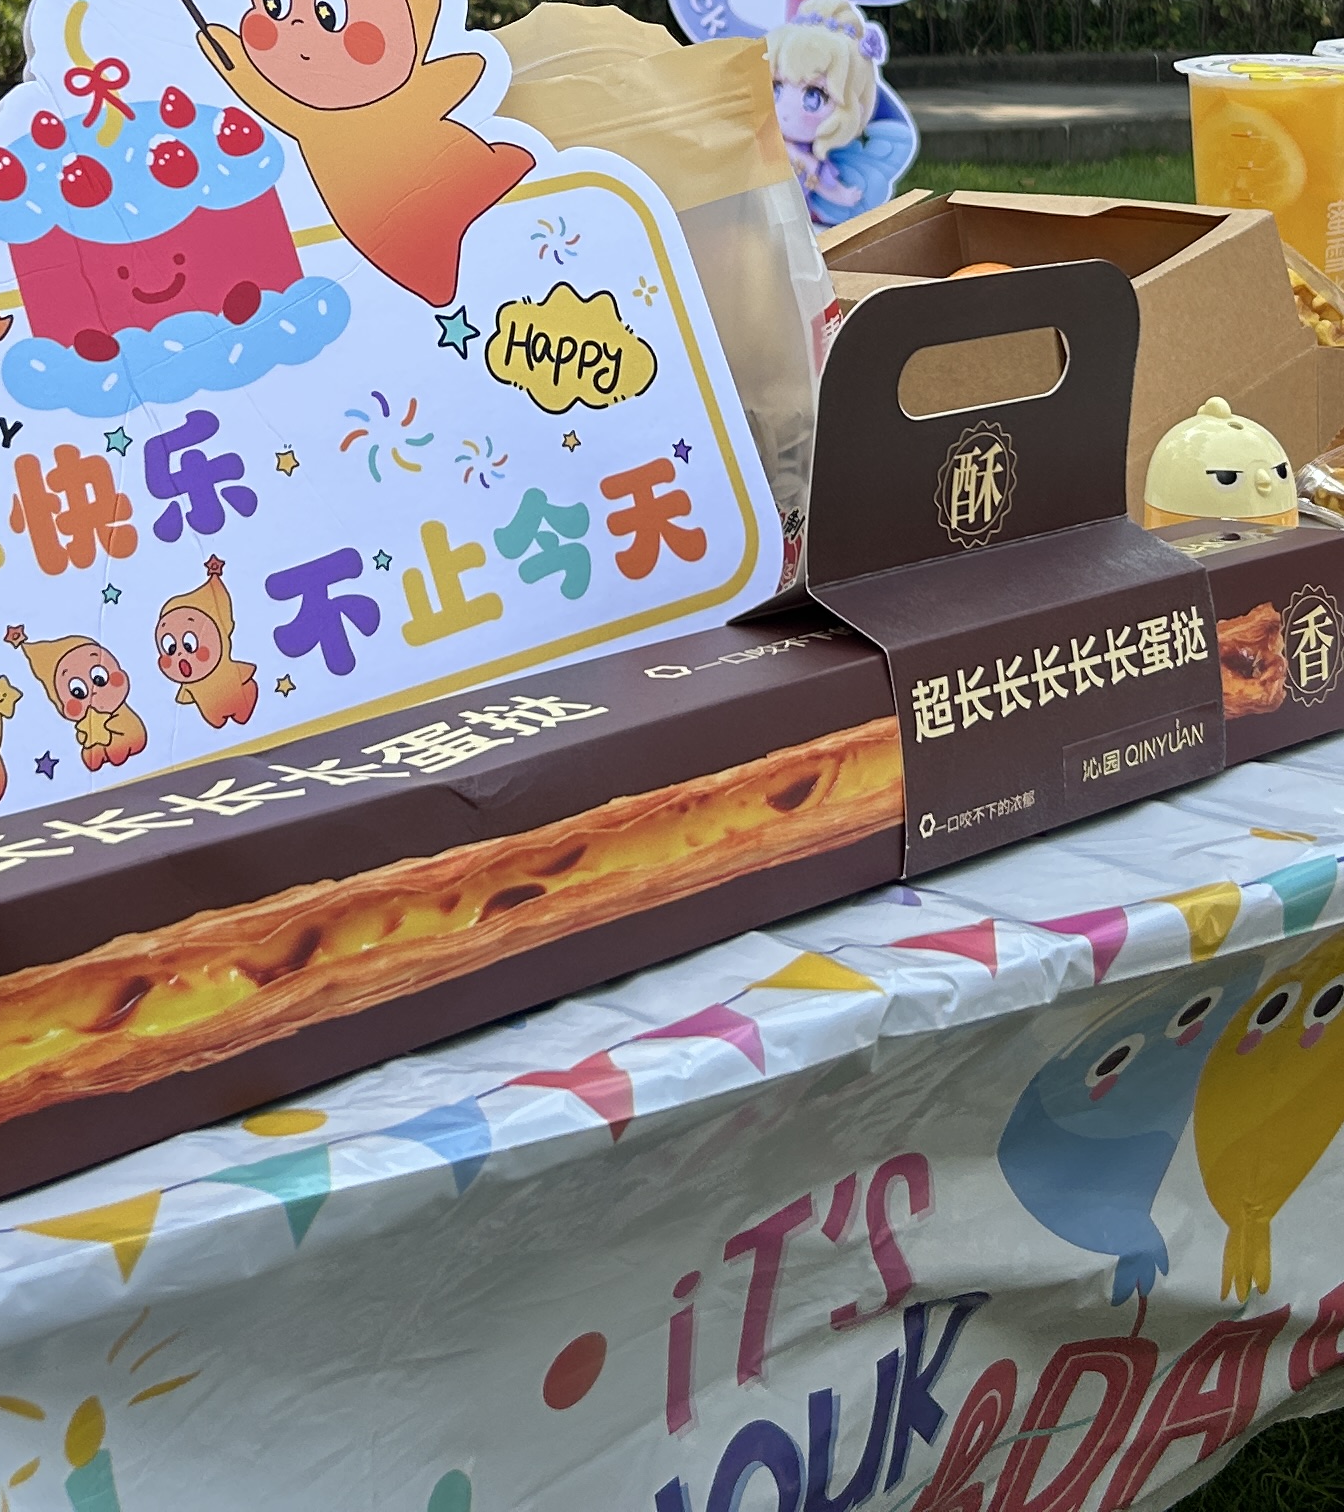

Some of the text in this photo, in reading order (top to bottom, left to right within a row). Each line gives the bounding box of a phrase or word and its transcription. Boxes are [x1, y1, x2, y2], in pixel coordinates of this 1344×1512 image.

[504, 319, 623, 395] Happy
[949, 443, 1002, 531] 酥
[263, 456, 709, 677] 不止今天
[911, 604, 1210, 743] 超长长长长长蛋挞
[1290, 604, 1335, 688] 香
[1082, 748, 1122, 783] 沁园
[933, 789, 1036, 834] 一口咬不下的浓郁
